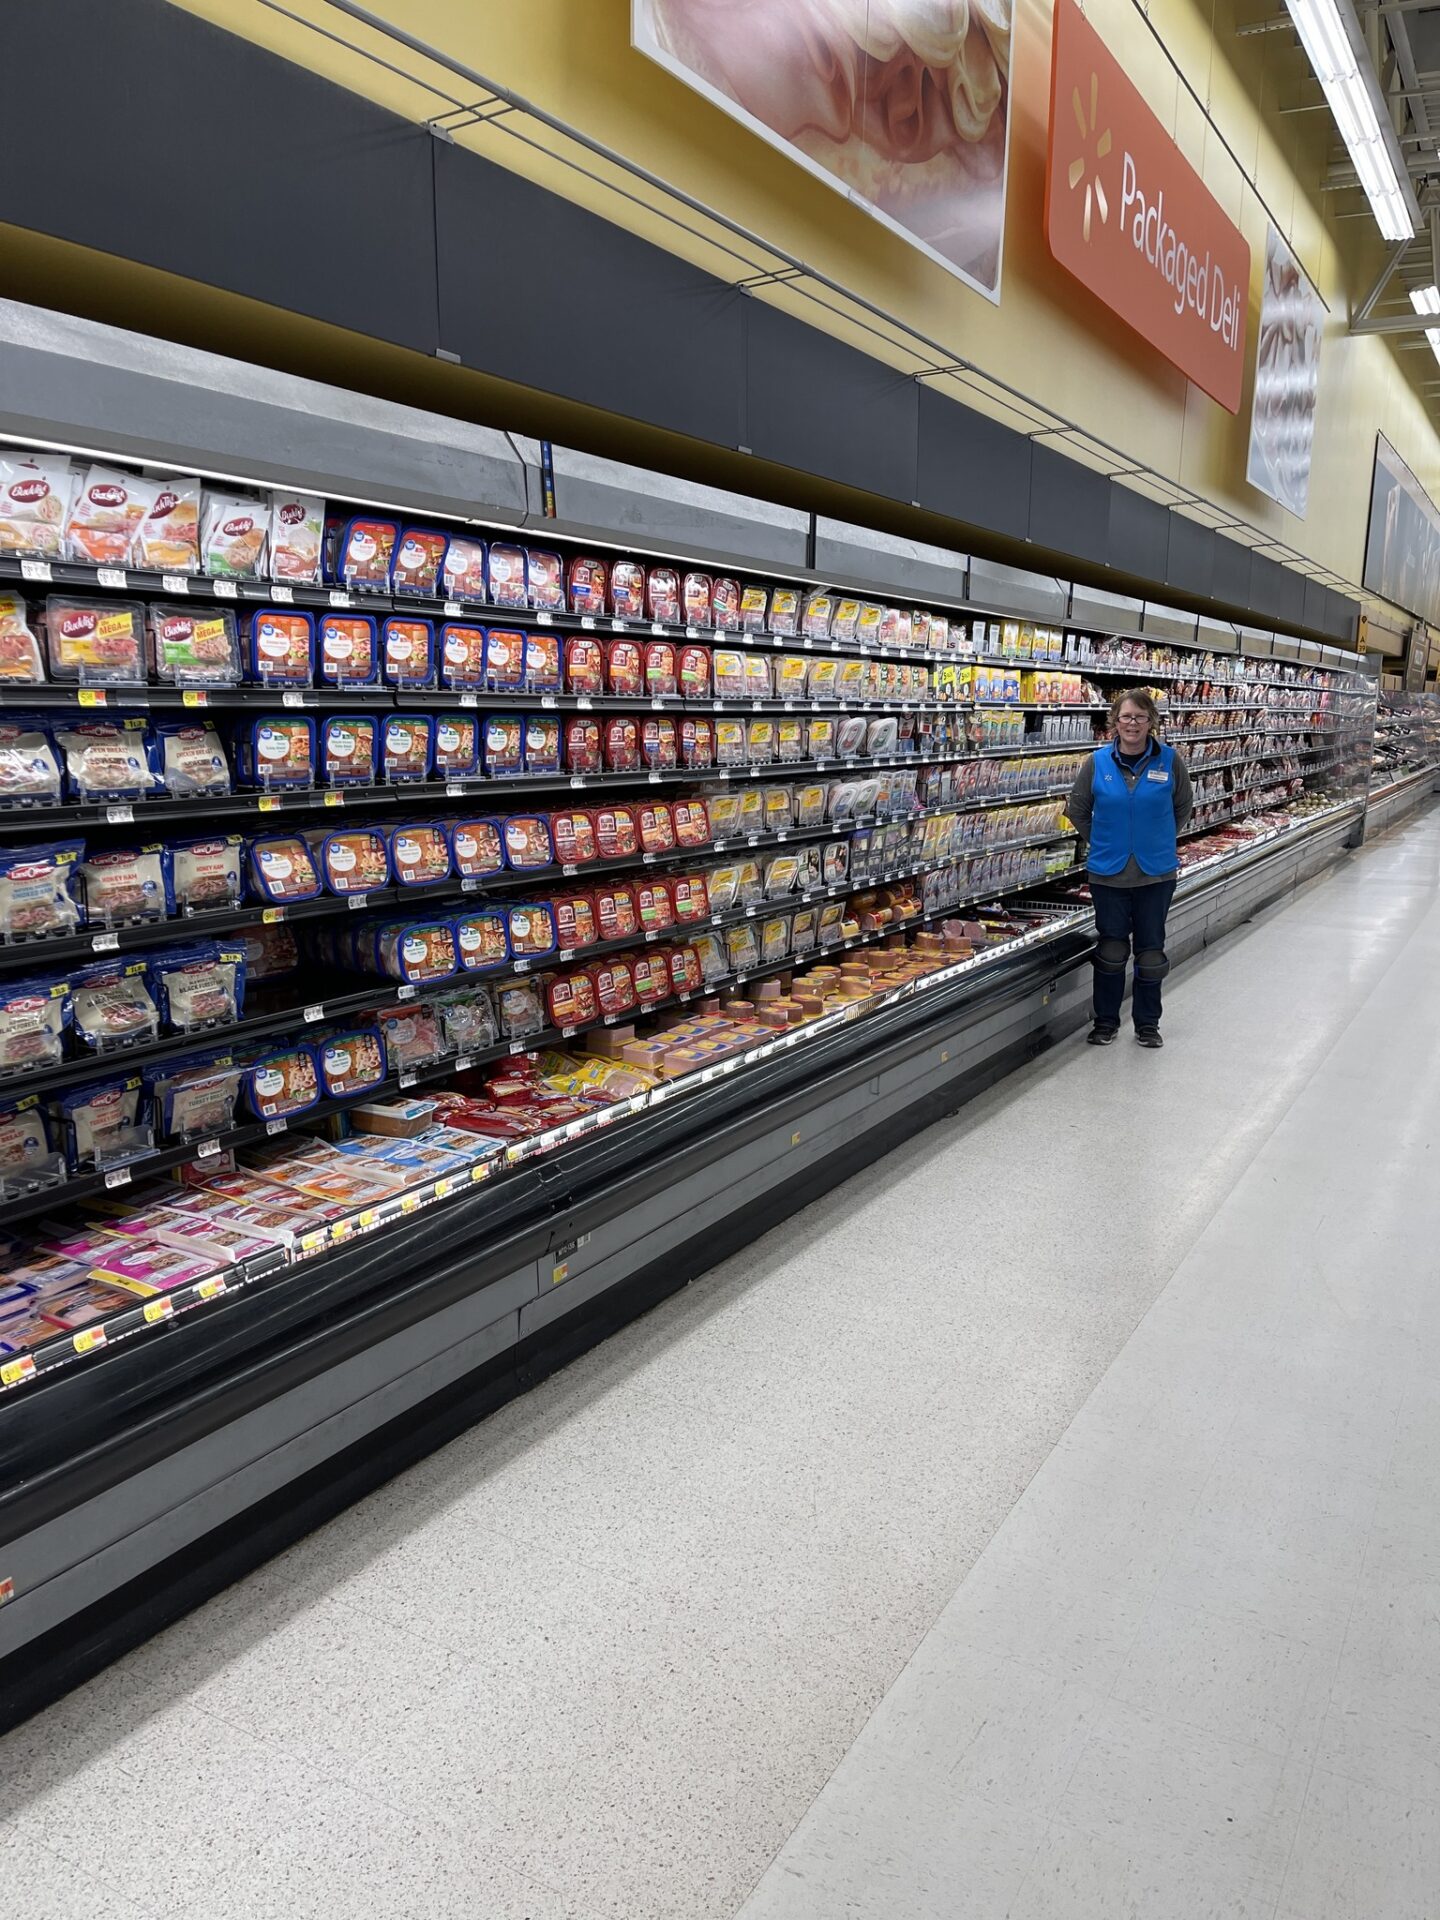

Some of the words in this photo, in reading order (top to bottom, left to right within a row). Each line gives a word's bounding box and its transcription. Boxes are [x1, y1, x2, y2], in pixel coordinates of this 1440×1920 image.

[1119, 151, 1210, 319] Packaged
[1210, 264, 1241, 352] Deli
[11, 484, 48, 497] Buddig
[62, 615, 95, 634] Buddig
[100, 622, 122, 634] MEGA
[164, 621, 192, 638] Buddig
[195, 627, 216, 638] MEGA
[179, 984, 198, 993] BLACK
